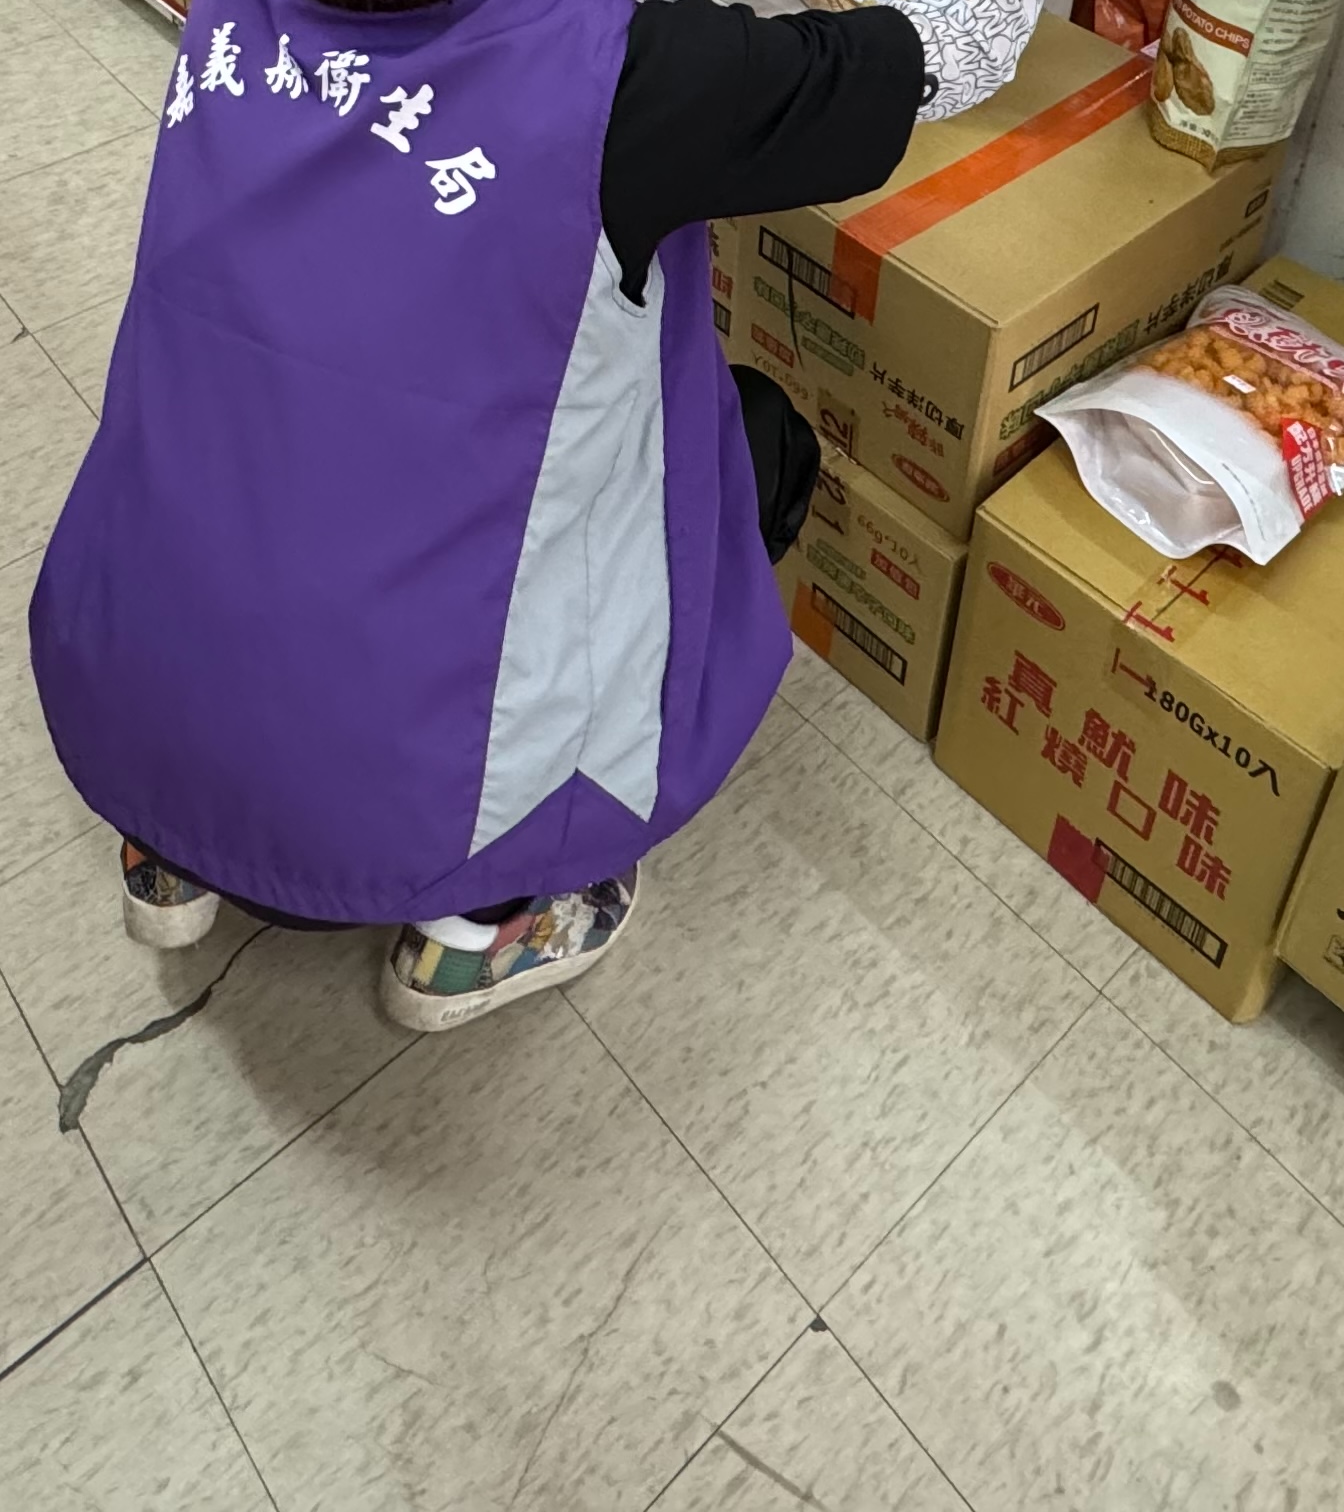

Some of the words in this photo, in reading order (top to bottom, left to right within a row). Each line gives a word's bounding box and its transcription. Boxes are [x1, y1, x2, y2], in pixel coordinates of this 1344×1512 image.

[1215, 26, 1251, 52] CHIPS
[979, 675, 1233, 902] 紅燒口味
[1008, 649, 1221, 845] 真魷味
